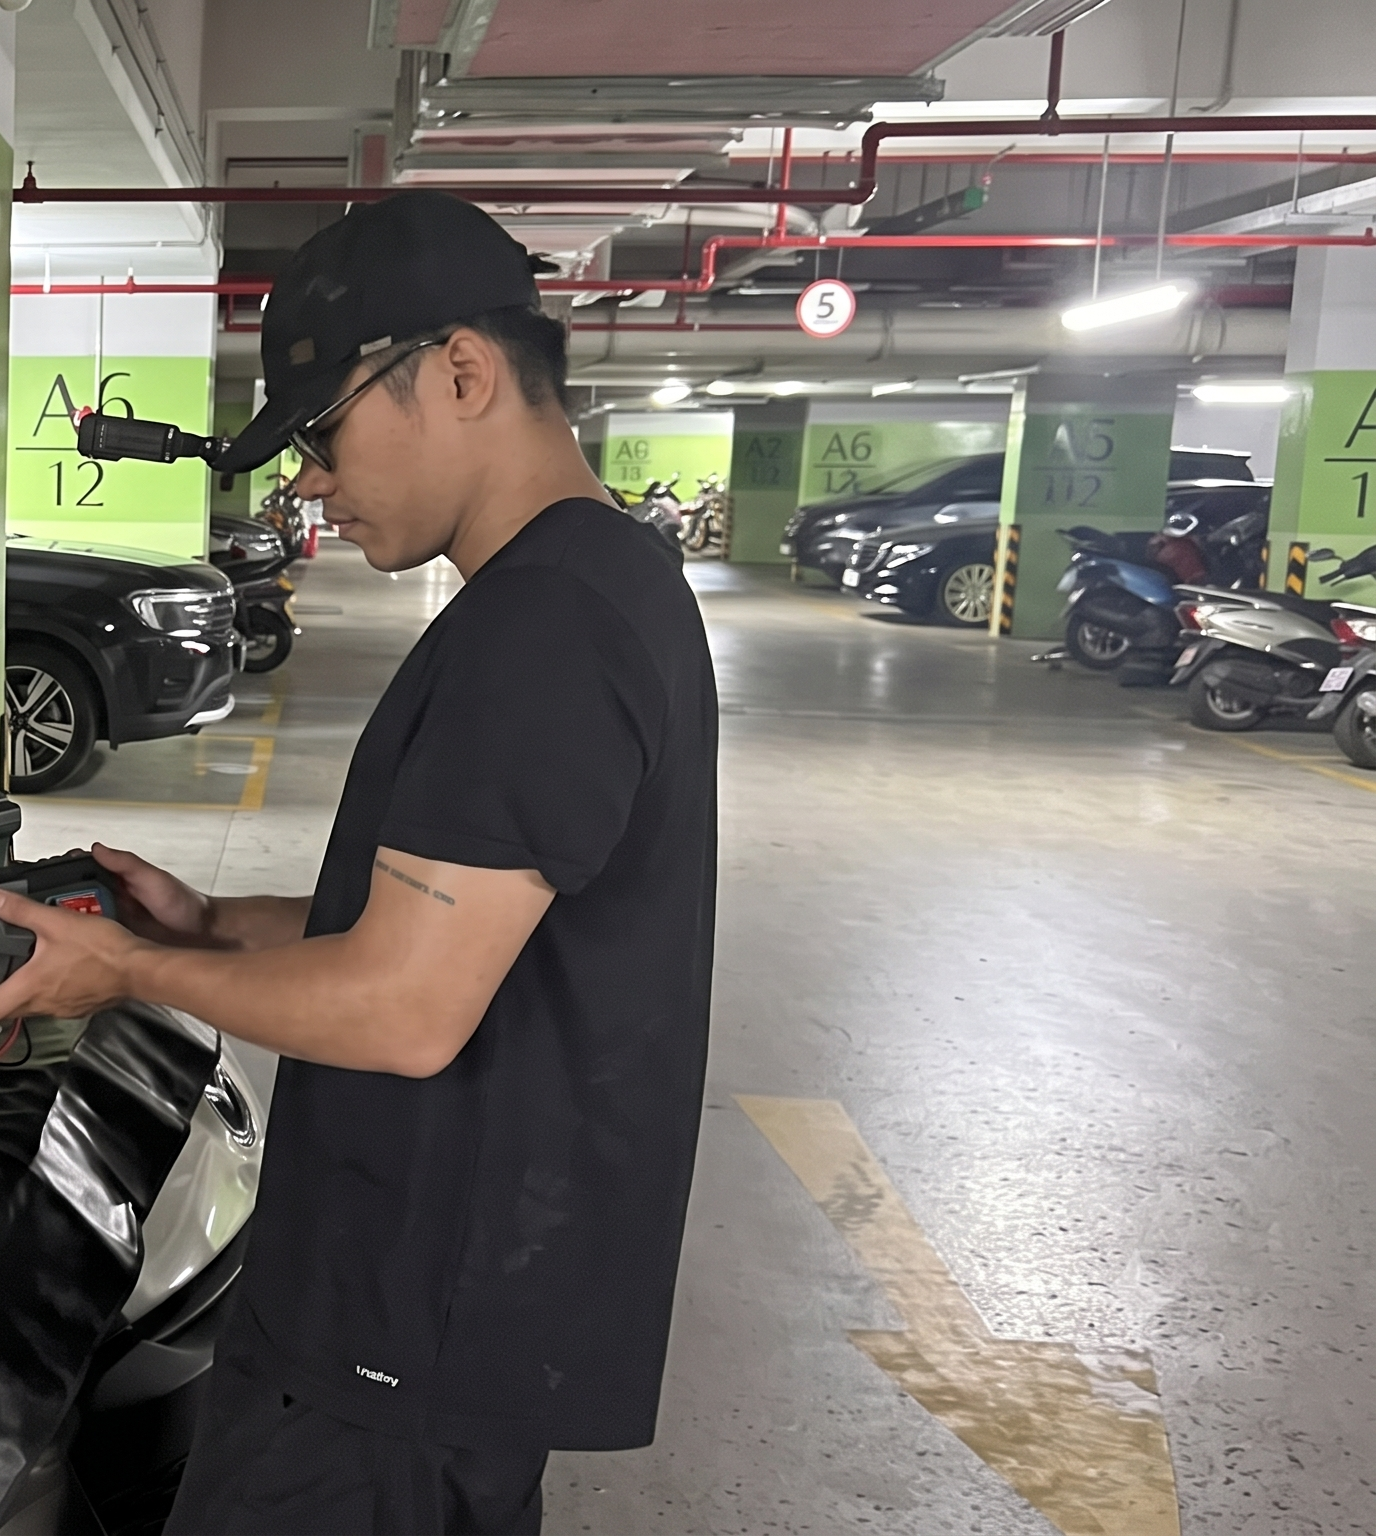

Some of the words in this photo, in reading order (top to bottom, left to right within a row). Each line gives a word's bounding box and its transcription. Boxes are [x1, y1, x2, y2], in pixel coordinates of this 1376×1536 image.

[816, 291, 835, 319] 5
[821, 430, 872, 461] A6
[48, 460, 104, 507] 12
